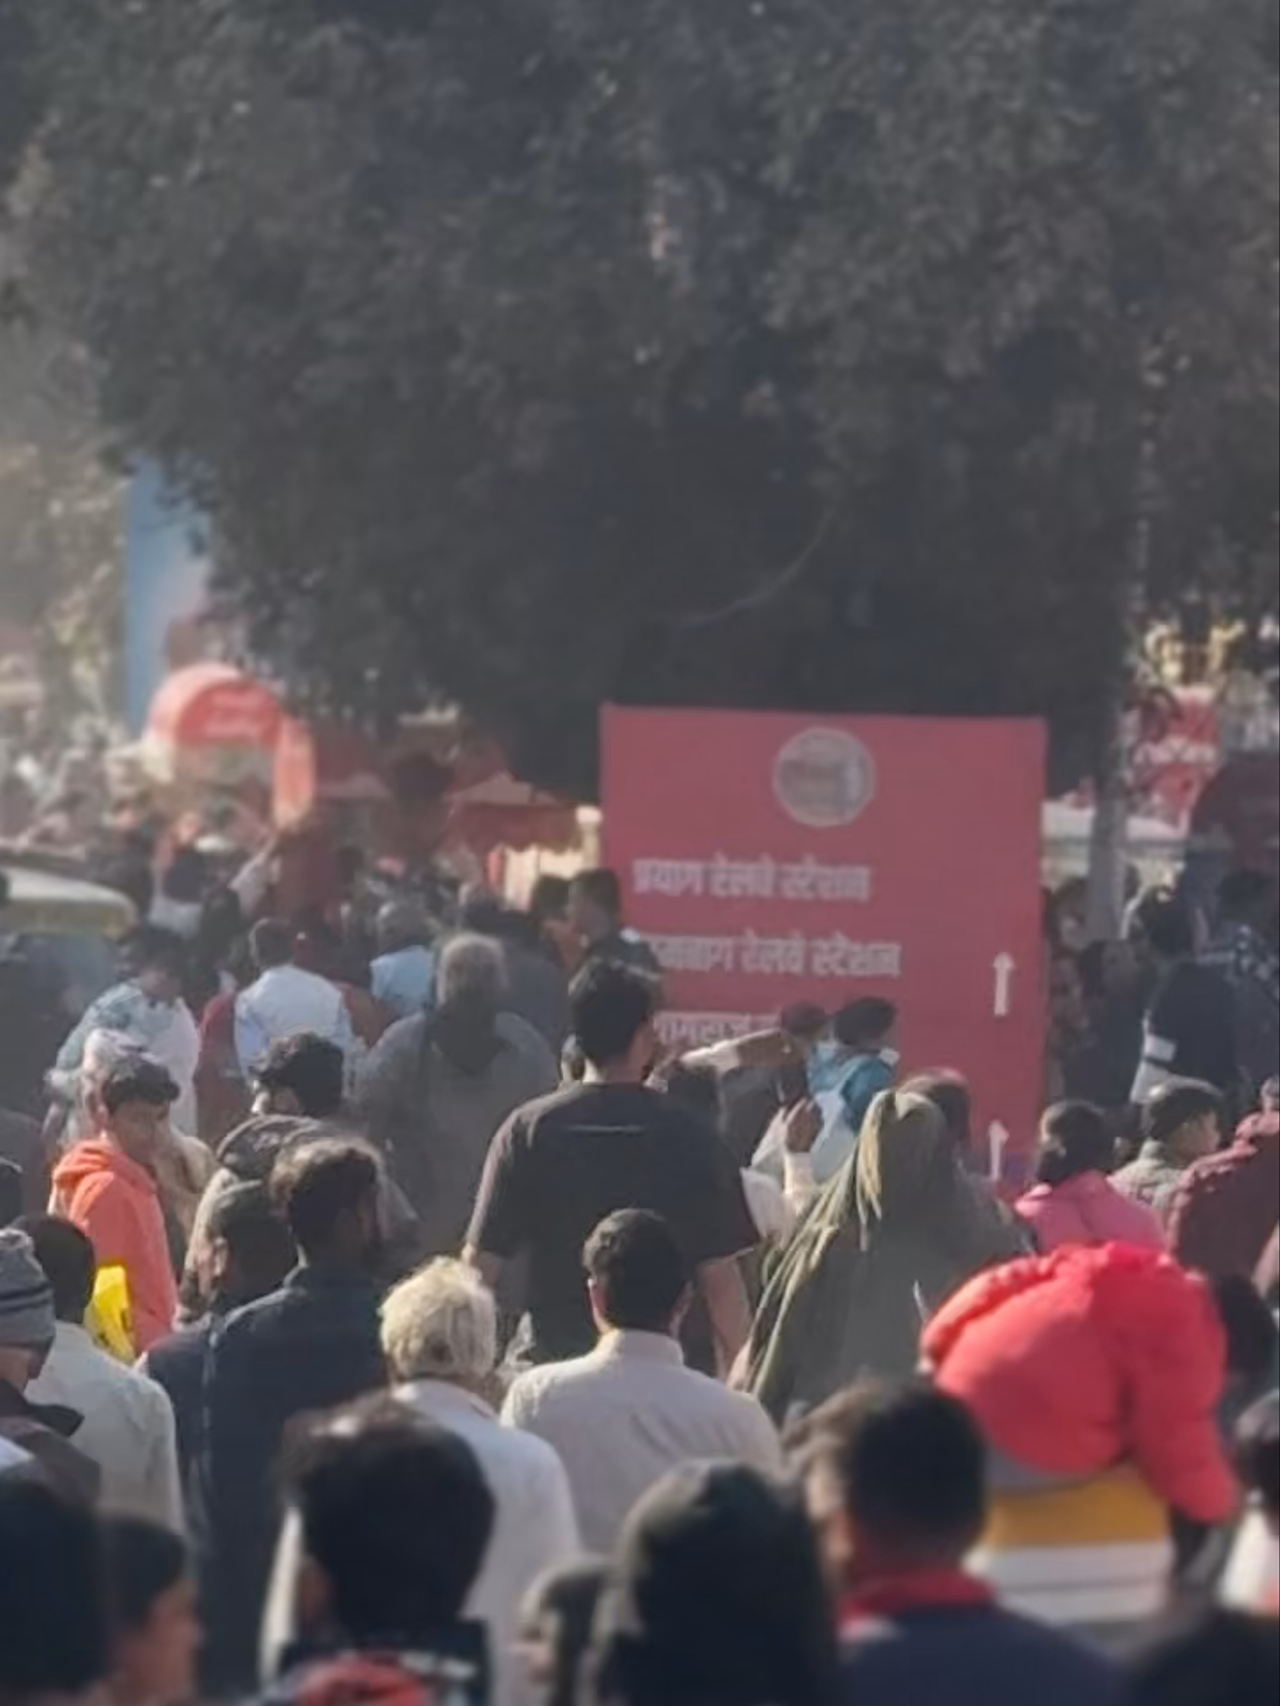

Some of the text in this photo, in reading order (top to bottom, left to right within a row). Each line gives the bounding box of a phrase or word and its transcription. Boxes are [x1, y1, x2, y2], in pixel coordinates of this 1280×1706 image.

[708, 849, 776, 899] रेलवे
[780, 852, 872, 904] स्टेशन
[739, 926, 807, 977] रेलवे
[811, 929, 902, 980] स्टेशन
